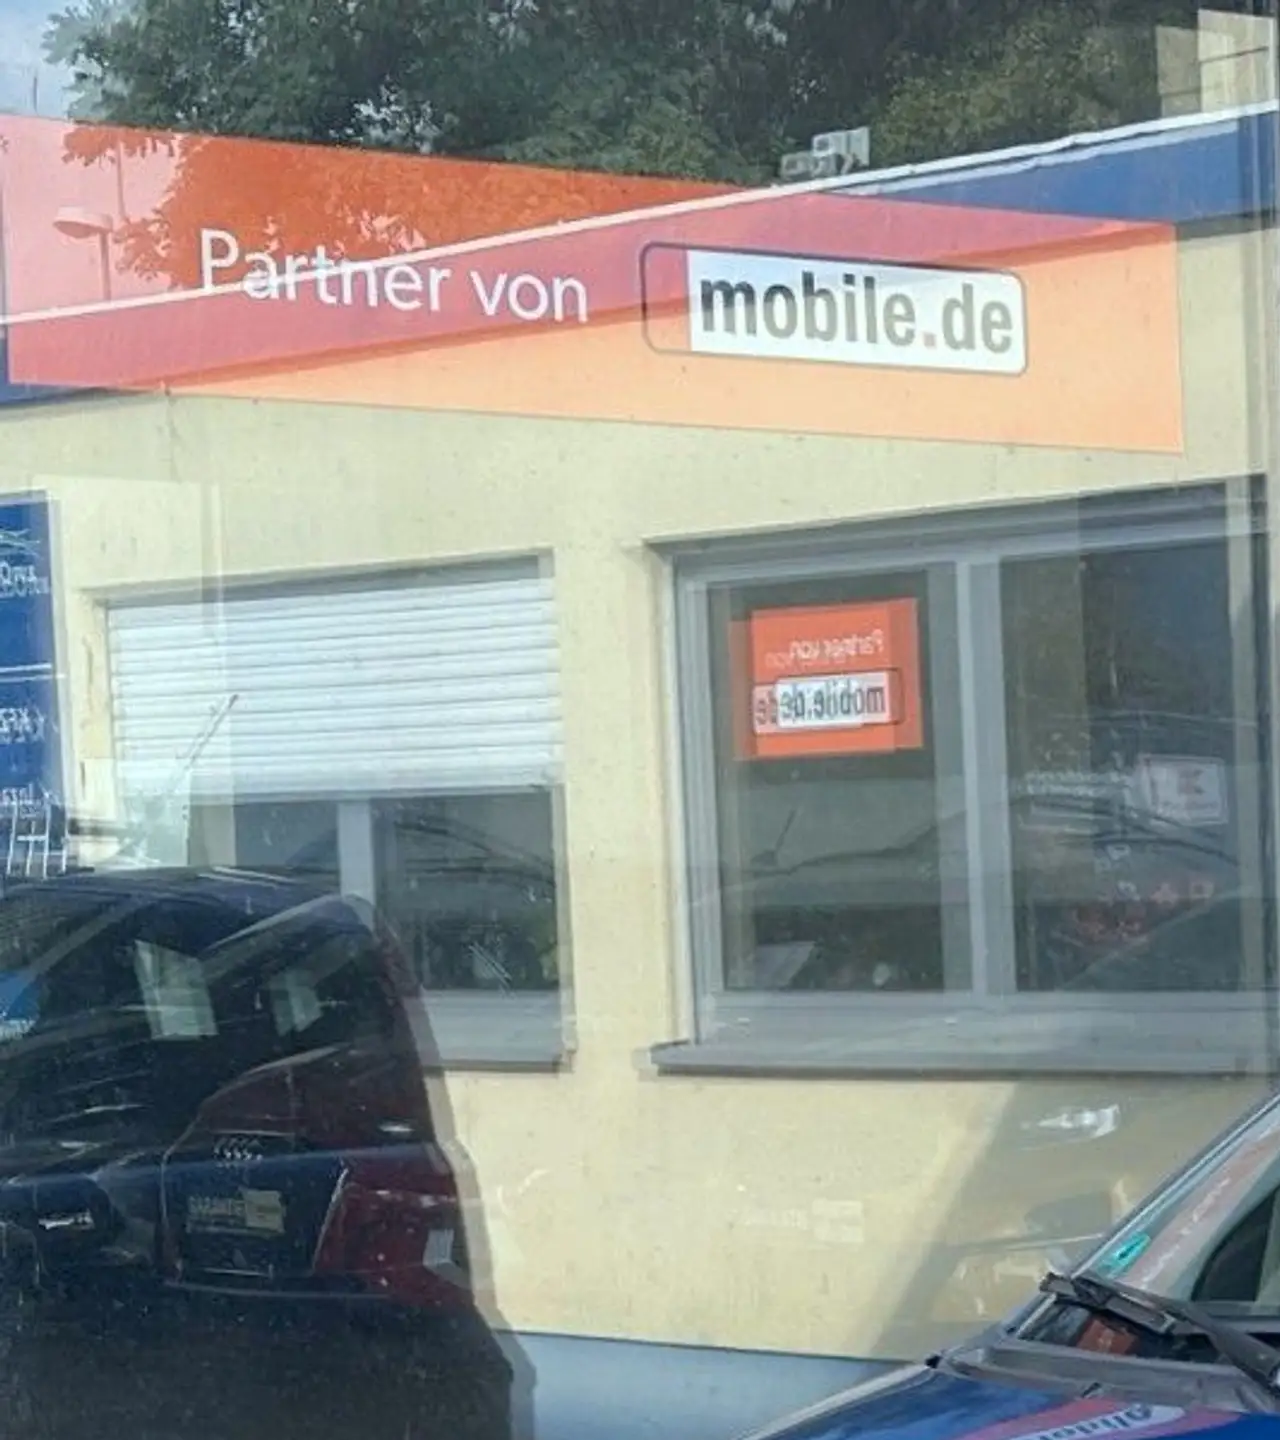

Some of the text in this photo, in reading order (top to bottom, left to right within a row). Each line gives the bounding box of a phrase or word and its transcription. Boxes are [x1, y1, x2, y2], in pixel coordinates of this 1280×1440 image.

[200, 228, 589, 323] Partner von
[700, 270, 1013, 354] mobile.de
